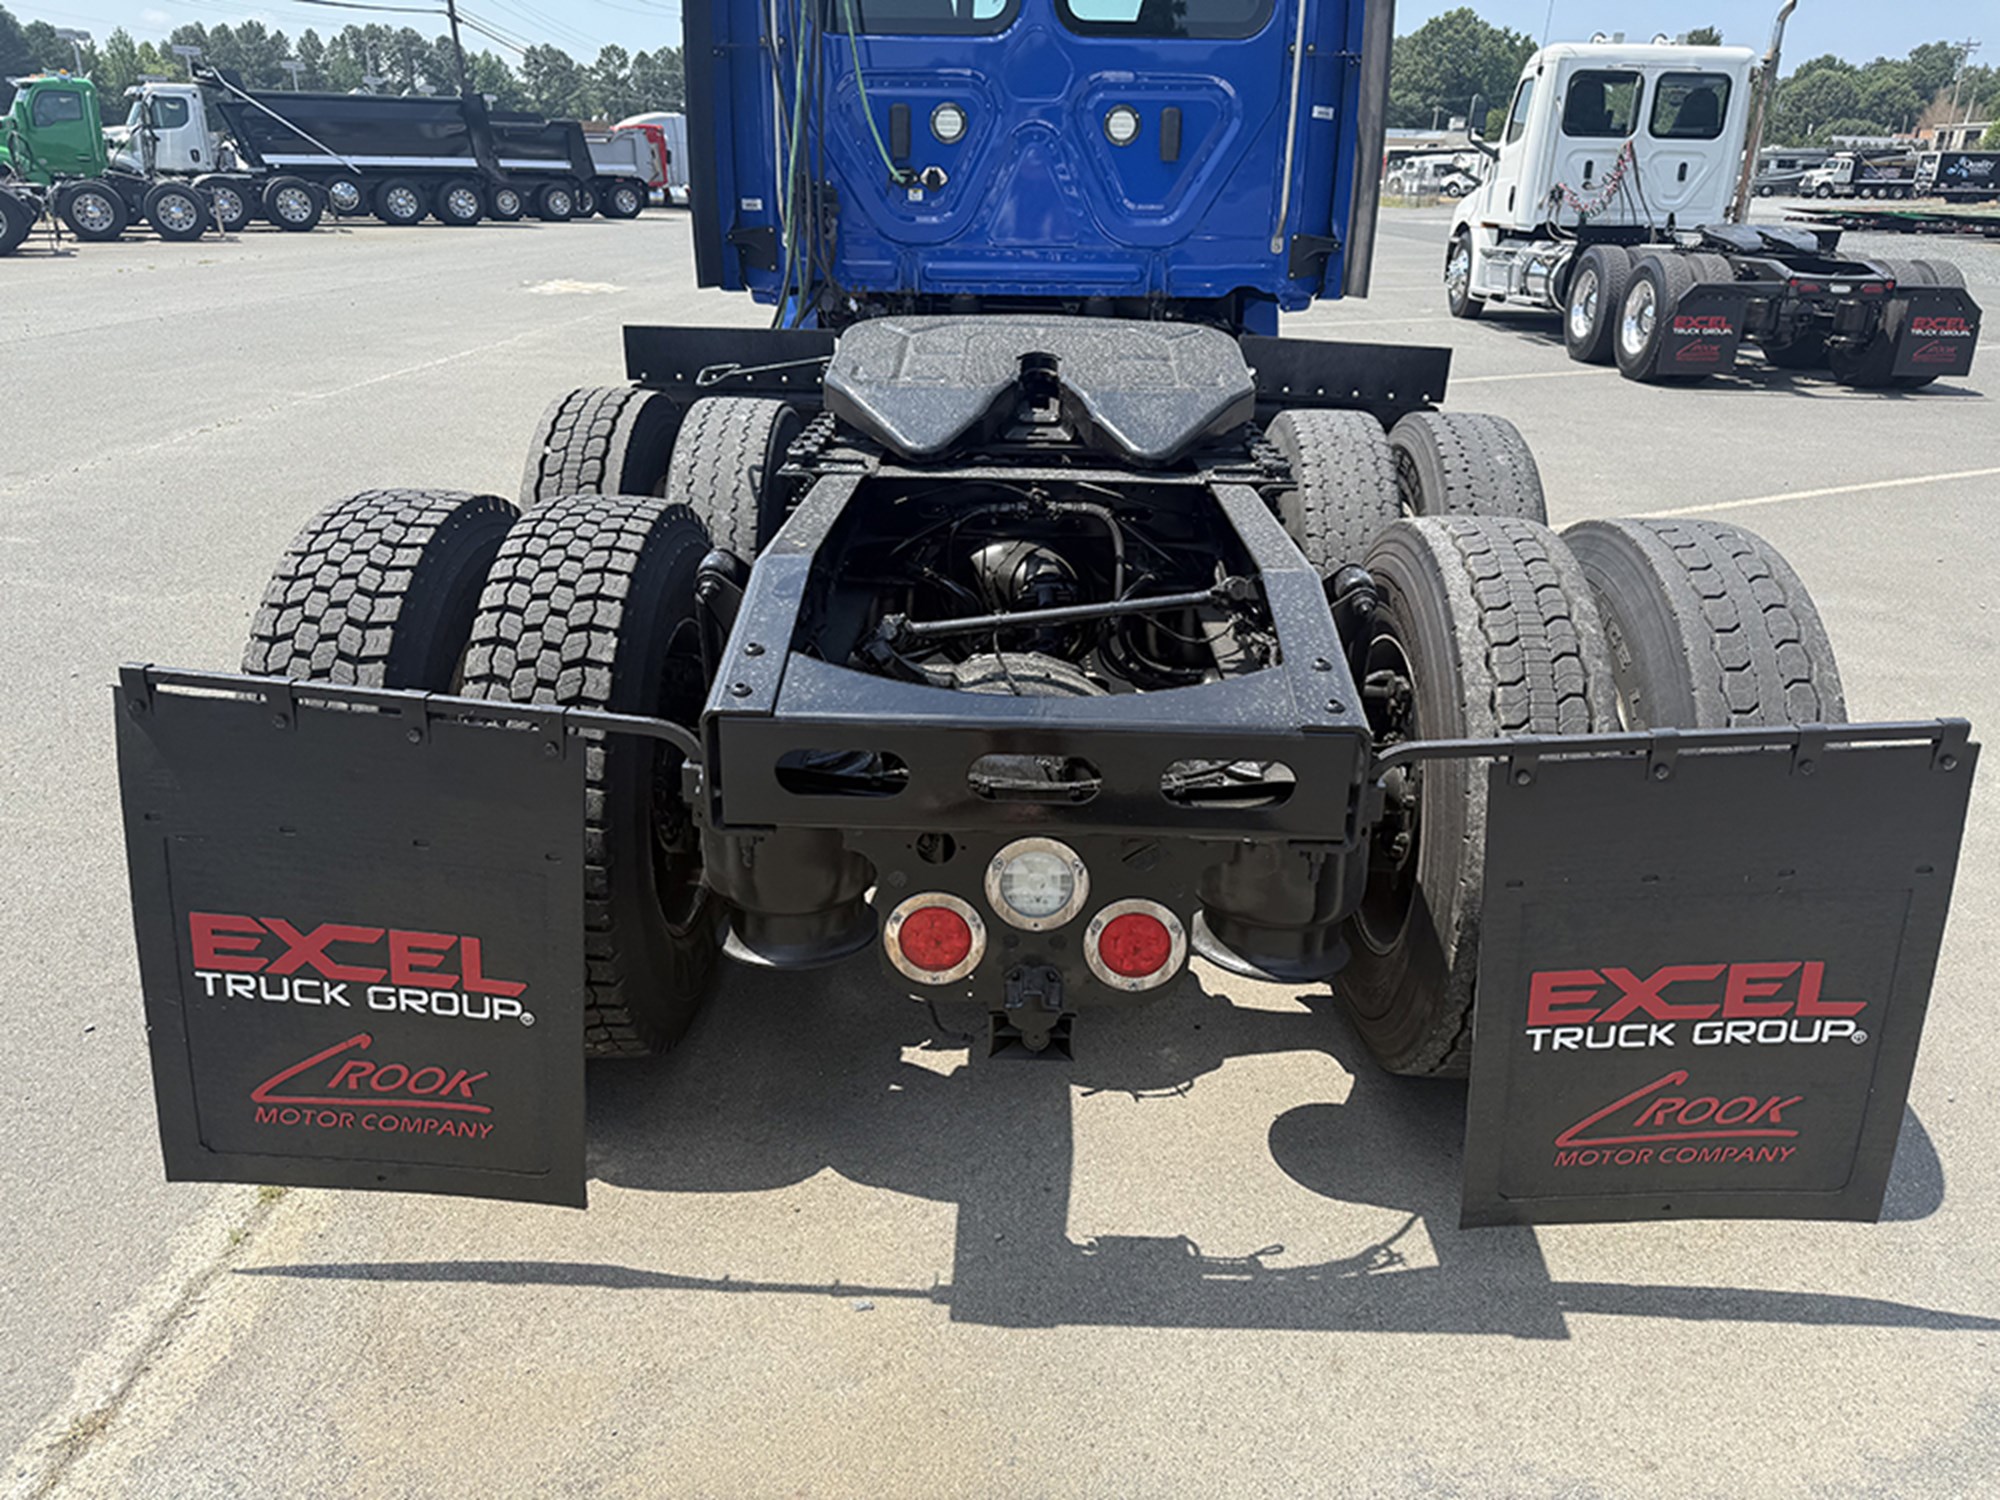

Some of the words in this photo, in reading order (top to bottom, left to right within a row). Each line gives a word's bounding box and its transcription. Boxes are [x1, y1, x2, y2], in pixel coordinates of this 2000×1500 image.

[1673, 315, 1733, 329] EXCEL
[1912, 316, 1970, 331] EXCEL
[189, 911, 527, 997] EXCEL
[194, 971, 351, 1007] TRUCK
[1526, 961, 1868, 1027] EXCEL
[1525, 1022, 1676, 1052] TRUCK
[255, 1107, 355, 1130] MOTOR
[361, 1113, 493, 1139] COMPANY
[1554, 1149, 1651, 1167] MOTOR
[1657, 1146, 1797, 1164] COMPANY
